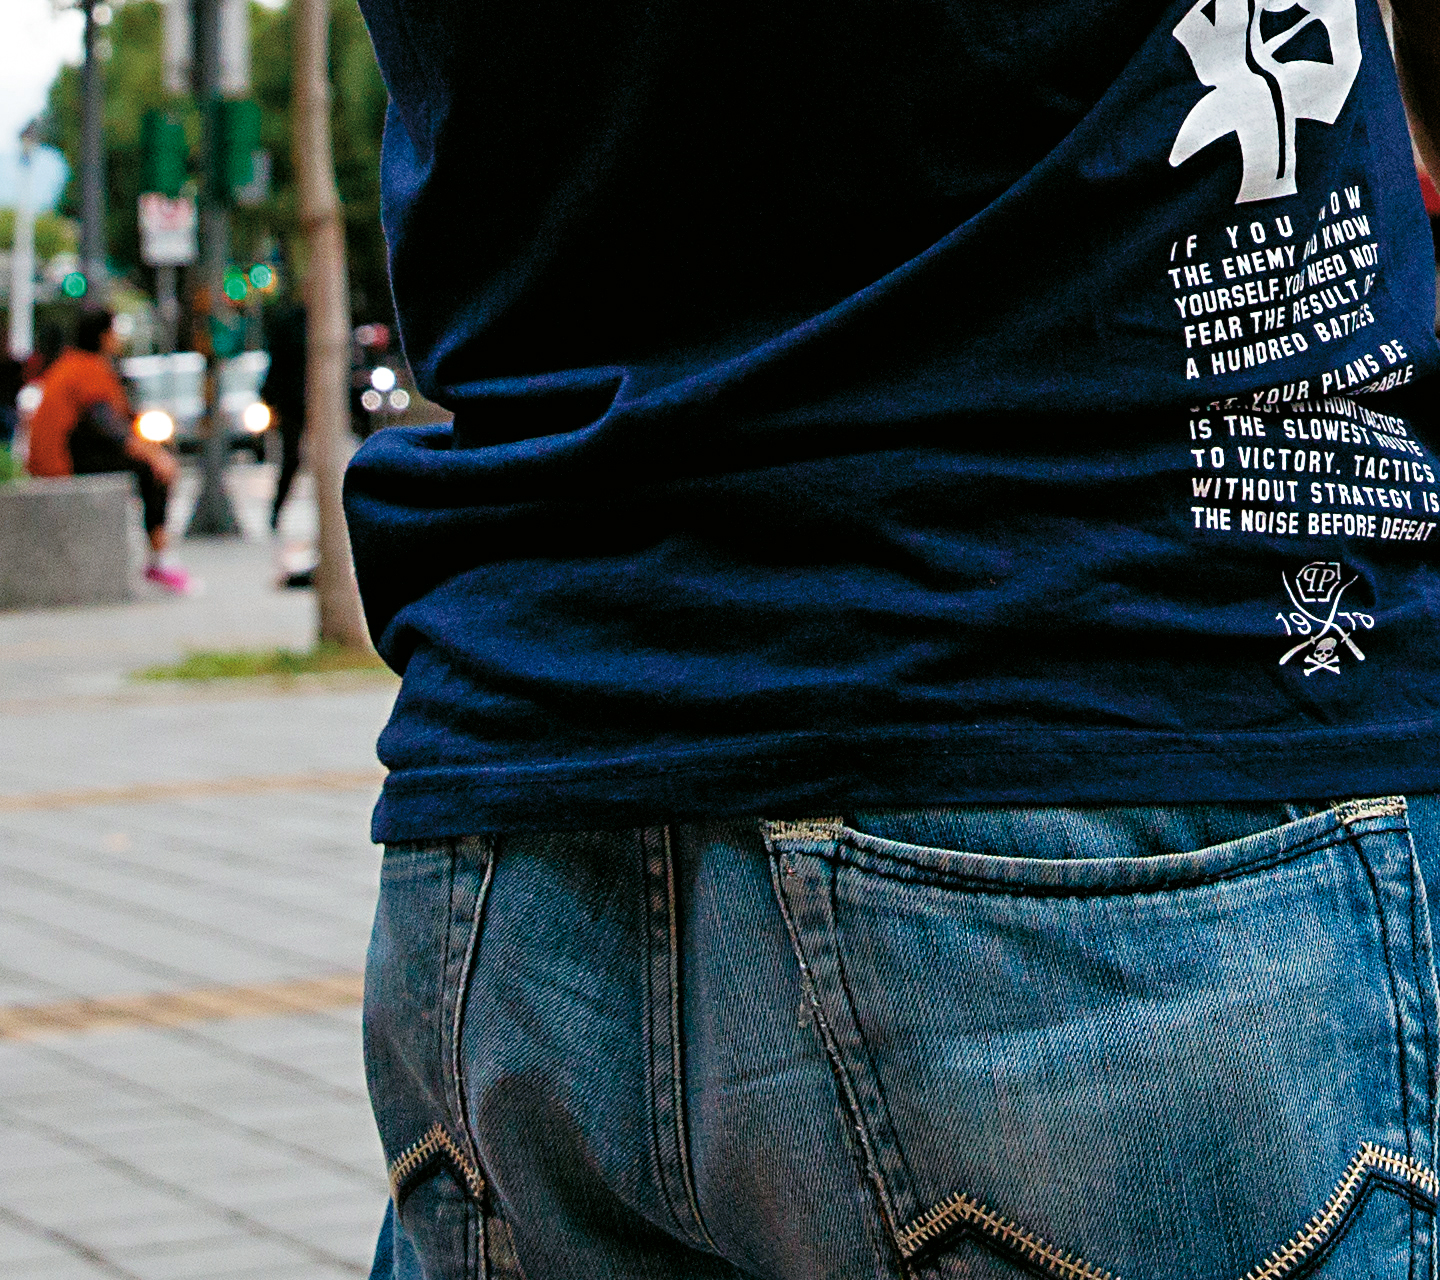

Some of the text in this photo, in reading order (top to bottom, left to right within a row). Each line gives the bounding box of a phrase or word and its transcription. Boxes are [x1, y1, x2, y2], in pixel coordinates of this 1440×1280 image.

[1170, 185, 1361, 262] IF YOU OW
[1168, 262, 1213, 289] THE
[1222, 245, 1295, 280] ENEMY
[1322, 215, 1371, 249] KNOW
[1285, 268, 1305, 297] YOU
[1307, 254, 1347, 287] NEED
[1349, 243, 1379, 269] NOT
[1184, 315, 1243, 349] FEAR
[1250, 306, 1286, 334] THE
[1293, 278, 1360, 325] RESULT
[1186, 357, 1200, 380] A
[1211, 332, 1308, 375] HUNDRED
[1252, 340, 1408, 405] YOUR PLANS BE
[1189, 415, 1424, 457] IS THE SLOWEST ROUTE
[1290, 396, 1358, 420] WITHOUT
[1358, 405, 1407, 437] TACTICS
[1190, 446, 1435, 484] TO VICTORY. TACTICS
[1192, 477, 1440, 513] WITHOUT STRATEGY IS
[1190, 506, 1437, 542] THE NOISE BEFORE DEFEAT
